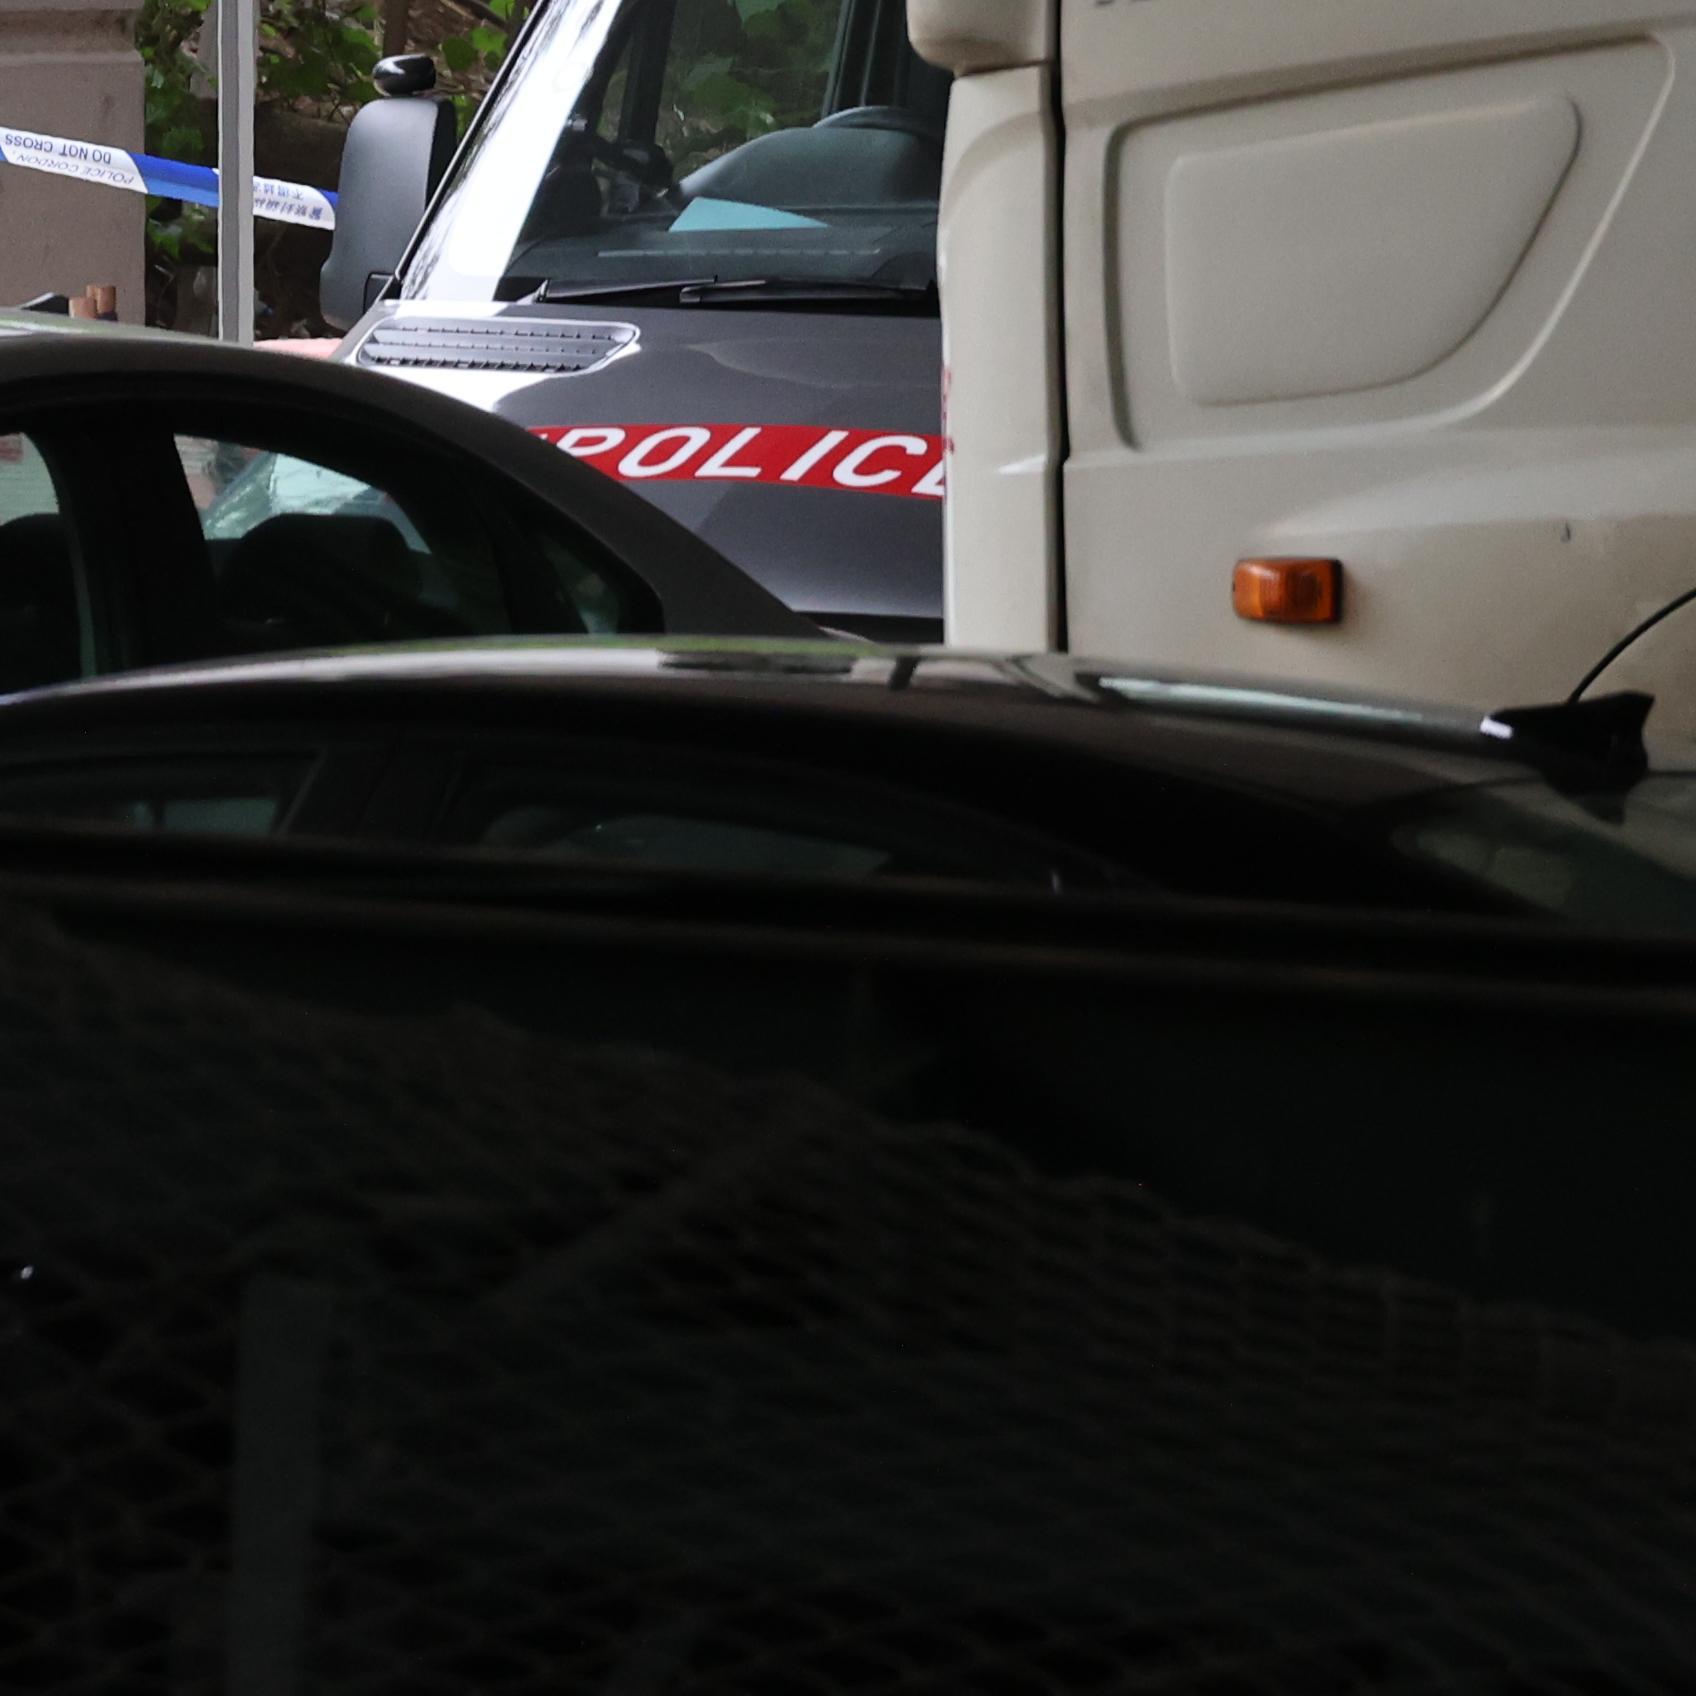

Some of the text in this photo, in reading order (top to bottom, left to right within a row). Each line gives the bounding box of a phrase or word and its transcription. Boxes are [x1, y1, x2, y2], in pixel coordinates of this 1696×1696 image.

[5, 133, 112, 165] DO NOT CROSS
[80, 164, 134, 185] POLICE
